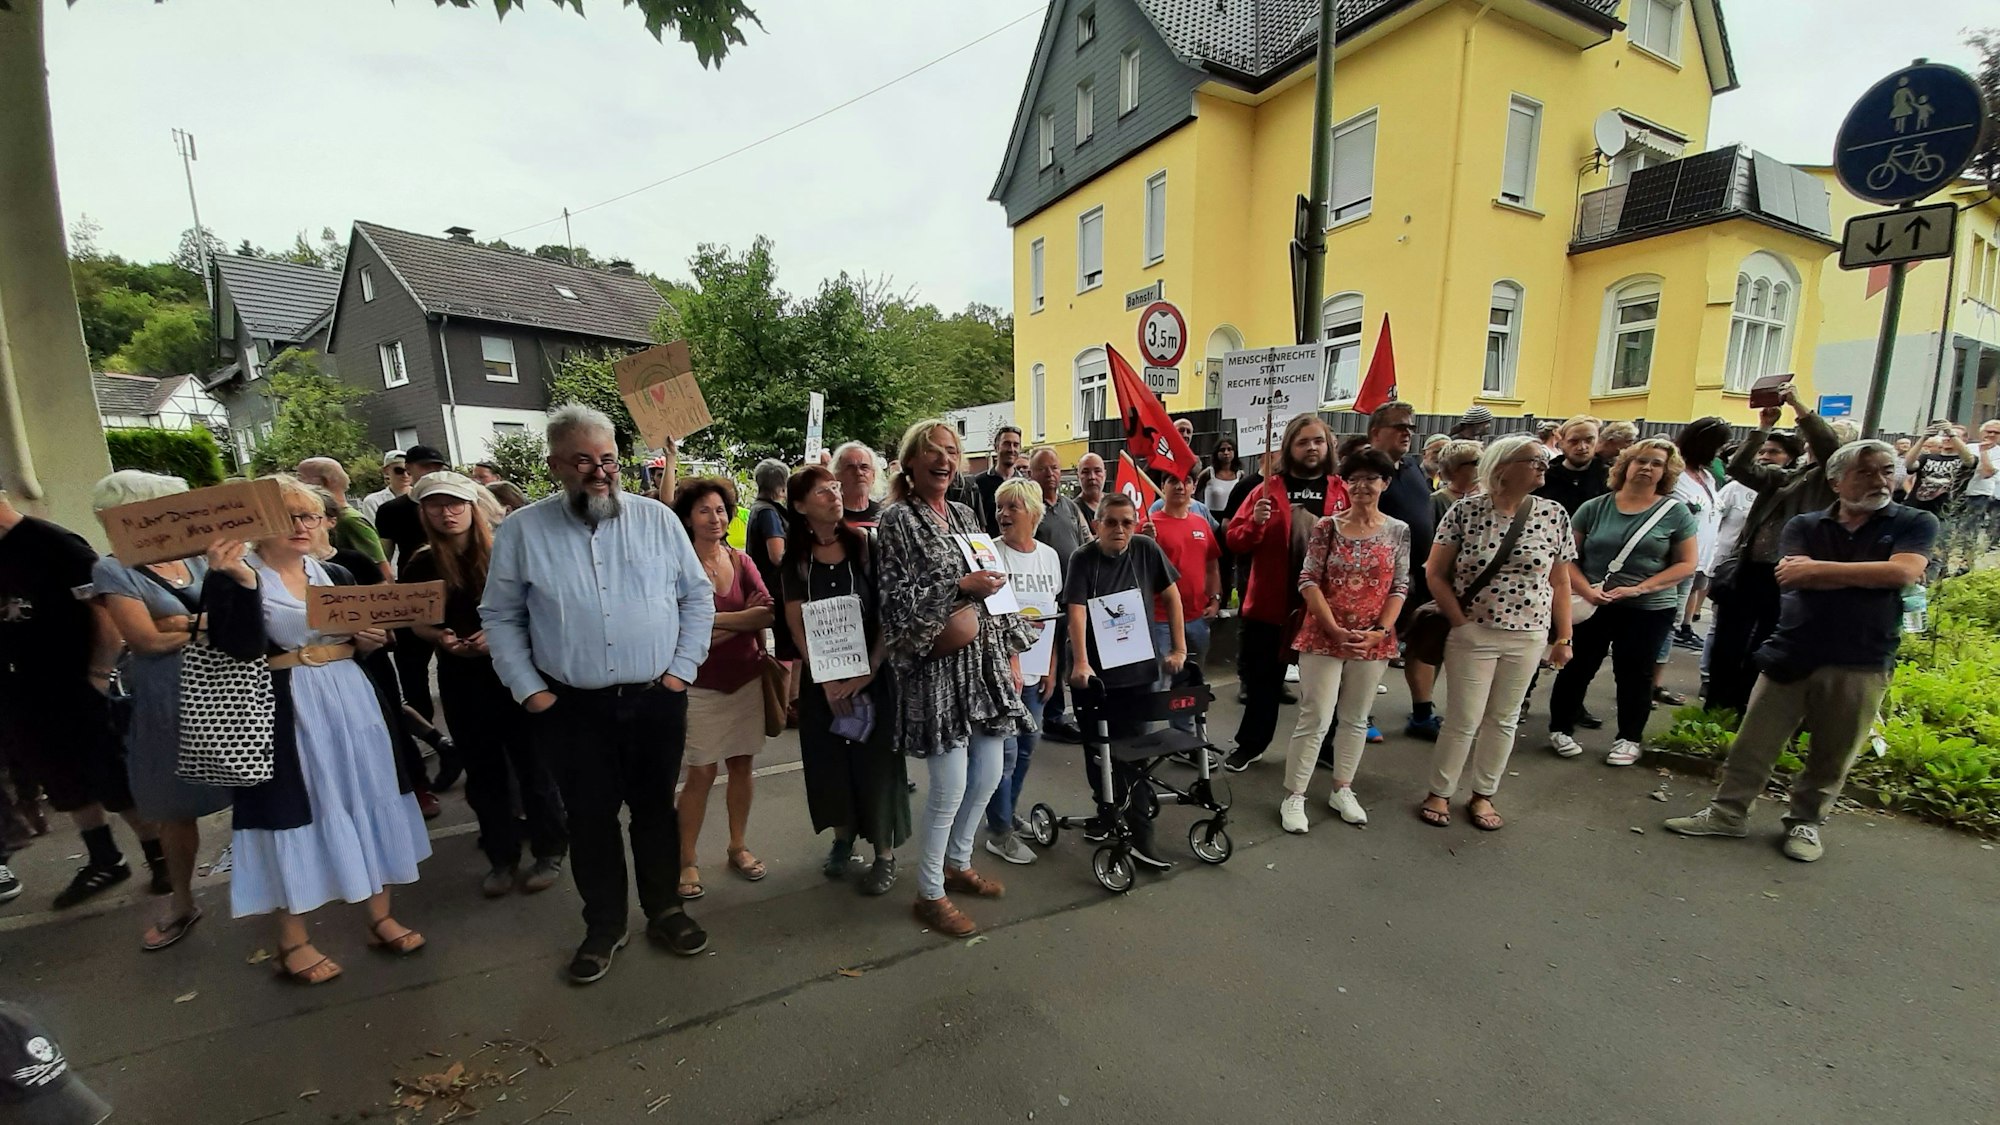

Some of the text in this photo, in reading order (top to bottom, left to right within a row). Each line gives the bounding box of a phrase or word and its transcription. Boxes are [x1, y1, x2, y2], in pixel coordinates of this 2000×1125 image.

[1127, 290, 1156, 308] Bahnstr.
[1228, 350, 1317, 366] MENSCHENRECHTE
[1260, 364, 1285, 375] STATT
[1147, 374, 1177, 388] 100 m
[1227, 374, 1315, 388] RECHTE MENSCHEN
[1240, 424, 1264, 434] RECHTE
[818, 653, 861, 671] MORD
